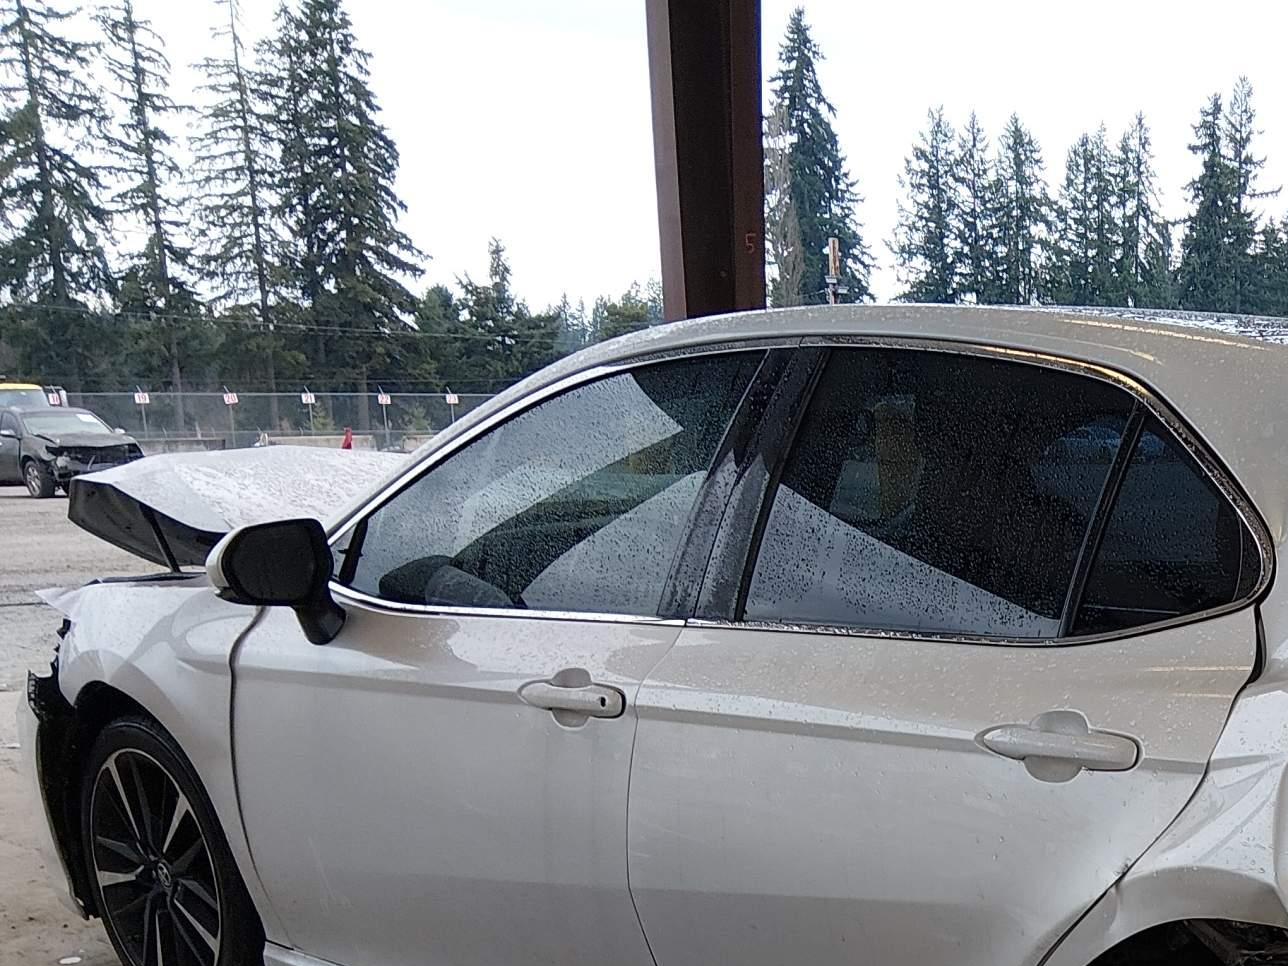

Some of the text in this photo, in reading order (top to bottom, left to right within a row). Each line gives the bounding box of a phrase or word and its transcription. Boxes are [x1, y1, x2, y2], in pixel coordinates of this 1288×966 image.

[745, 232, 757, 254] 5
[137, 394, 147, 402] 19
[226, 394, 237, 403] 20
[304, 394, 313, 402] 21
[379, 394, 389, 403] 22
